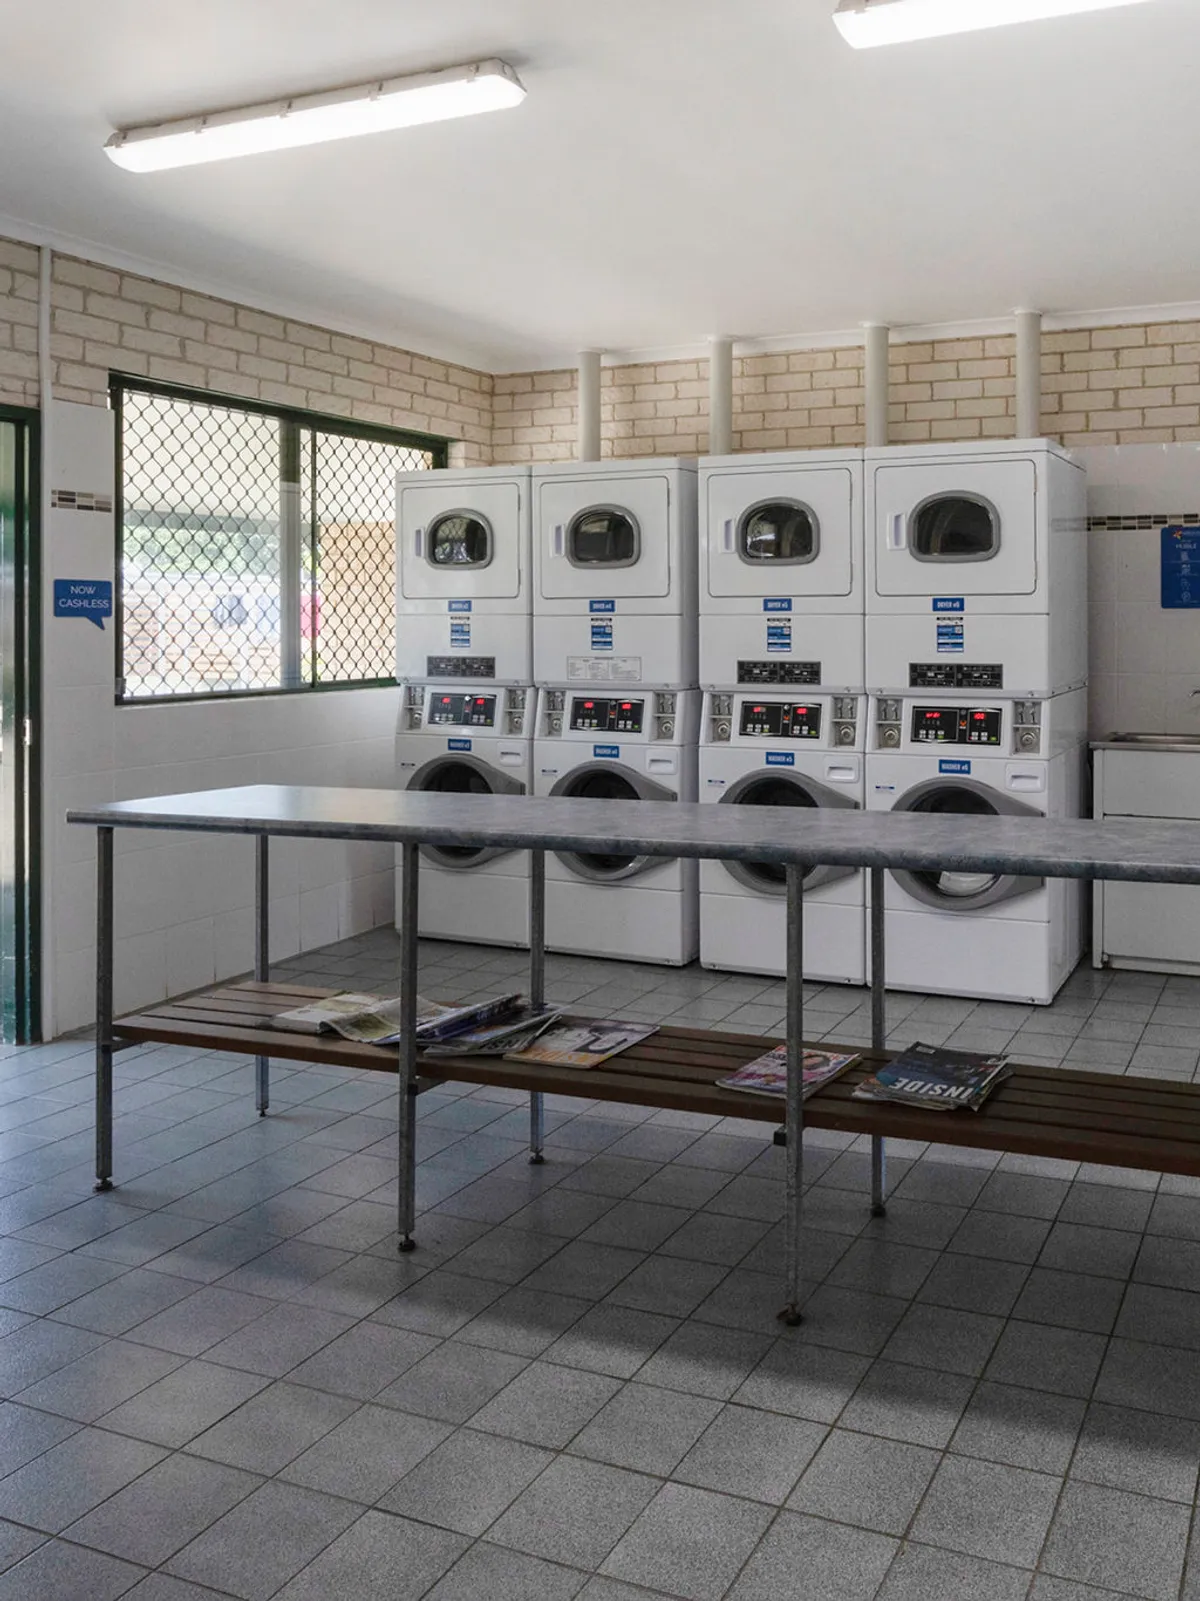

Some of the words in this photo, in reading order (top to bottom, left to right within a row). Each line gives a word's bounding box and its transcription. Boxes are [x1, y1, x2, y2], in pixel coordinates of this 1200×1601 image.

[70, 585, 96, 594] NOW
[58, 598, 109, 608] CASHLESS
[888, 1077, 974, 1099] INSIDE
